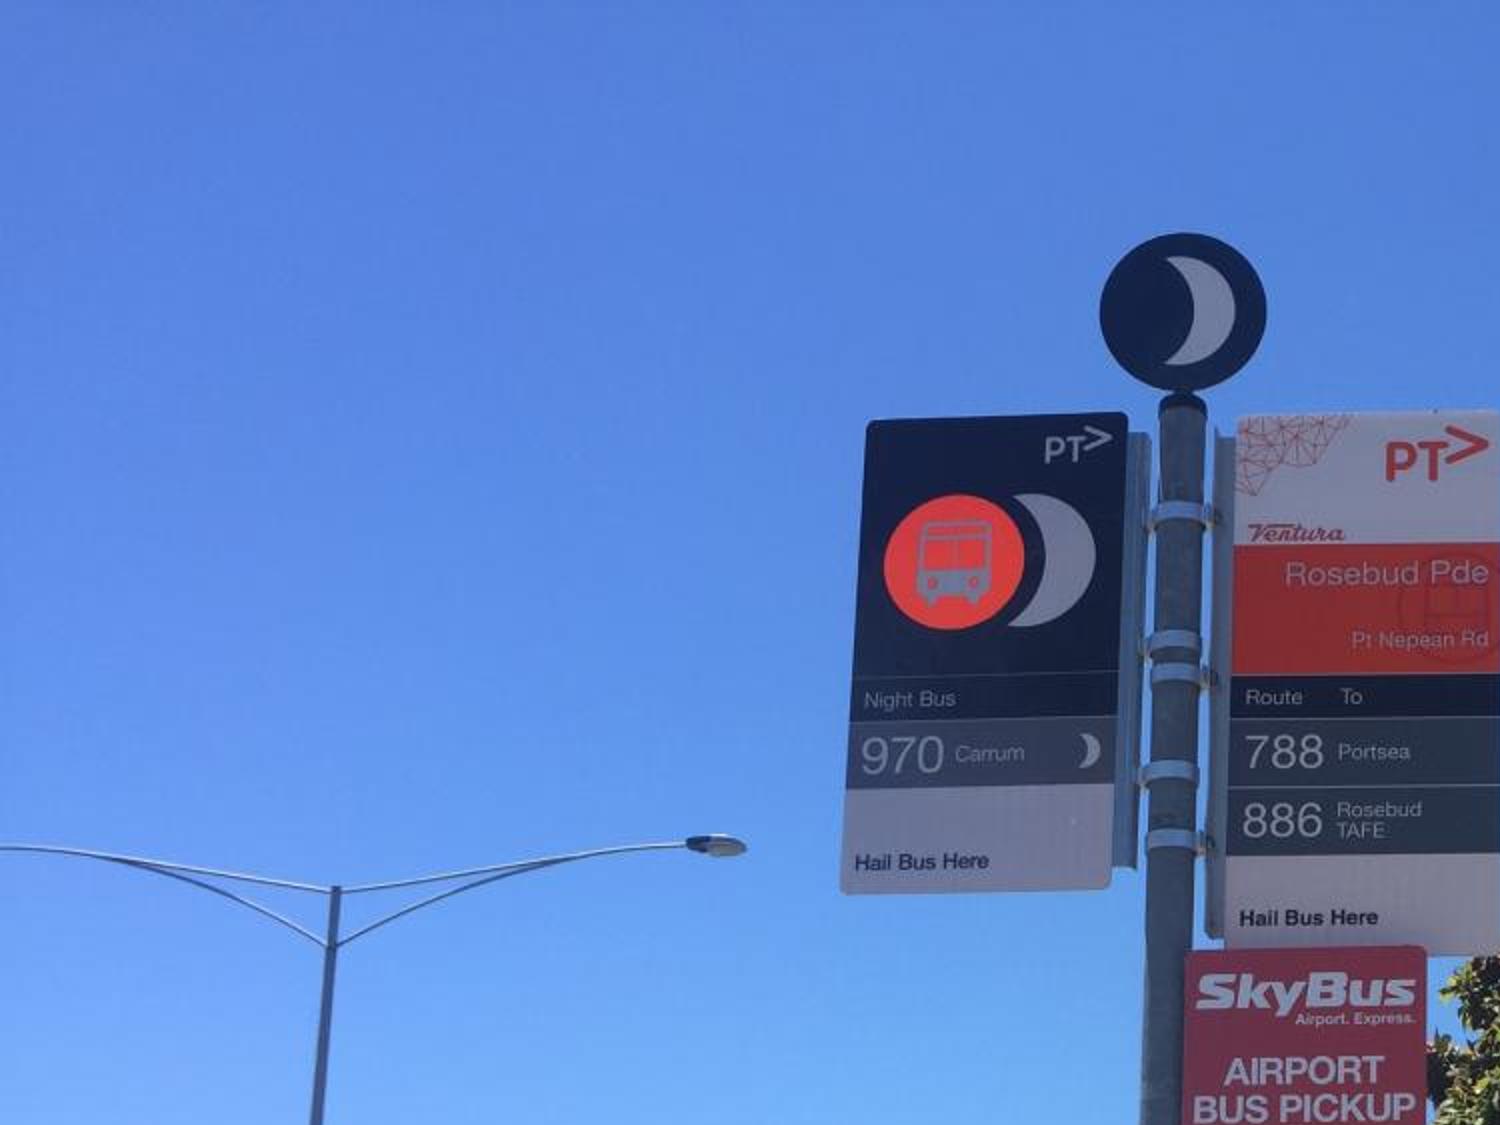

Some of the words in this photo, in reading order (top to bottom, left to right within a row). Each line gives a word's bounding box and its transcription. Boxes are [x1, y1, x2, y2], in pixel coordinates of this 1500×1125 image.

[1247, 523, 1346, 544] Ventura
[1285, 560, 1420, 586] Rosebud
[1430, 558, 1490, 584] Pde
[1351, 631, 1375, 650] Pt
[1378, 631, 1455, 653] Nepean
[1460, 629, 1490, 649] Rd
[863, 690, 913, 710] Night
[919, 689, 957, 708] Bus
[1245, 689, 1303, 706] Route
[1340, 688, 1363, 705] To
[861, 735, 944, 776] 970
[955, 744, 1025, 763] Carrum
[1245, 734, 1323, 769] 788
[1337, 743, 1411, 762] Portsea
[1242, 803, 1323, 838] 886
[1336, 801, 1423, 819] Rosebud
[1336, 821, 1386, 840] TAFE
[854, 853, 891, 872] Hail
[897, 852, 936, 872] Bus
[942, 851, 990, 871] Here
[1239, 909, 1279, 928] Hail
[1284, 909, 1324, 926] Bus
[1331, 908, 1379, 926] Here
[1196, 970, 1416, 1017] SkyBus
[1223, 1055, 1386, 1086] AIRPORT
[1193, 1096, 1269, 1125] BUS
[1280, 1093, 1417, 1124] PICKUP
